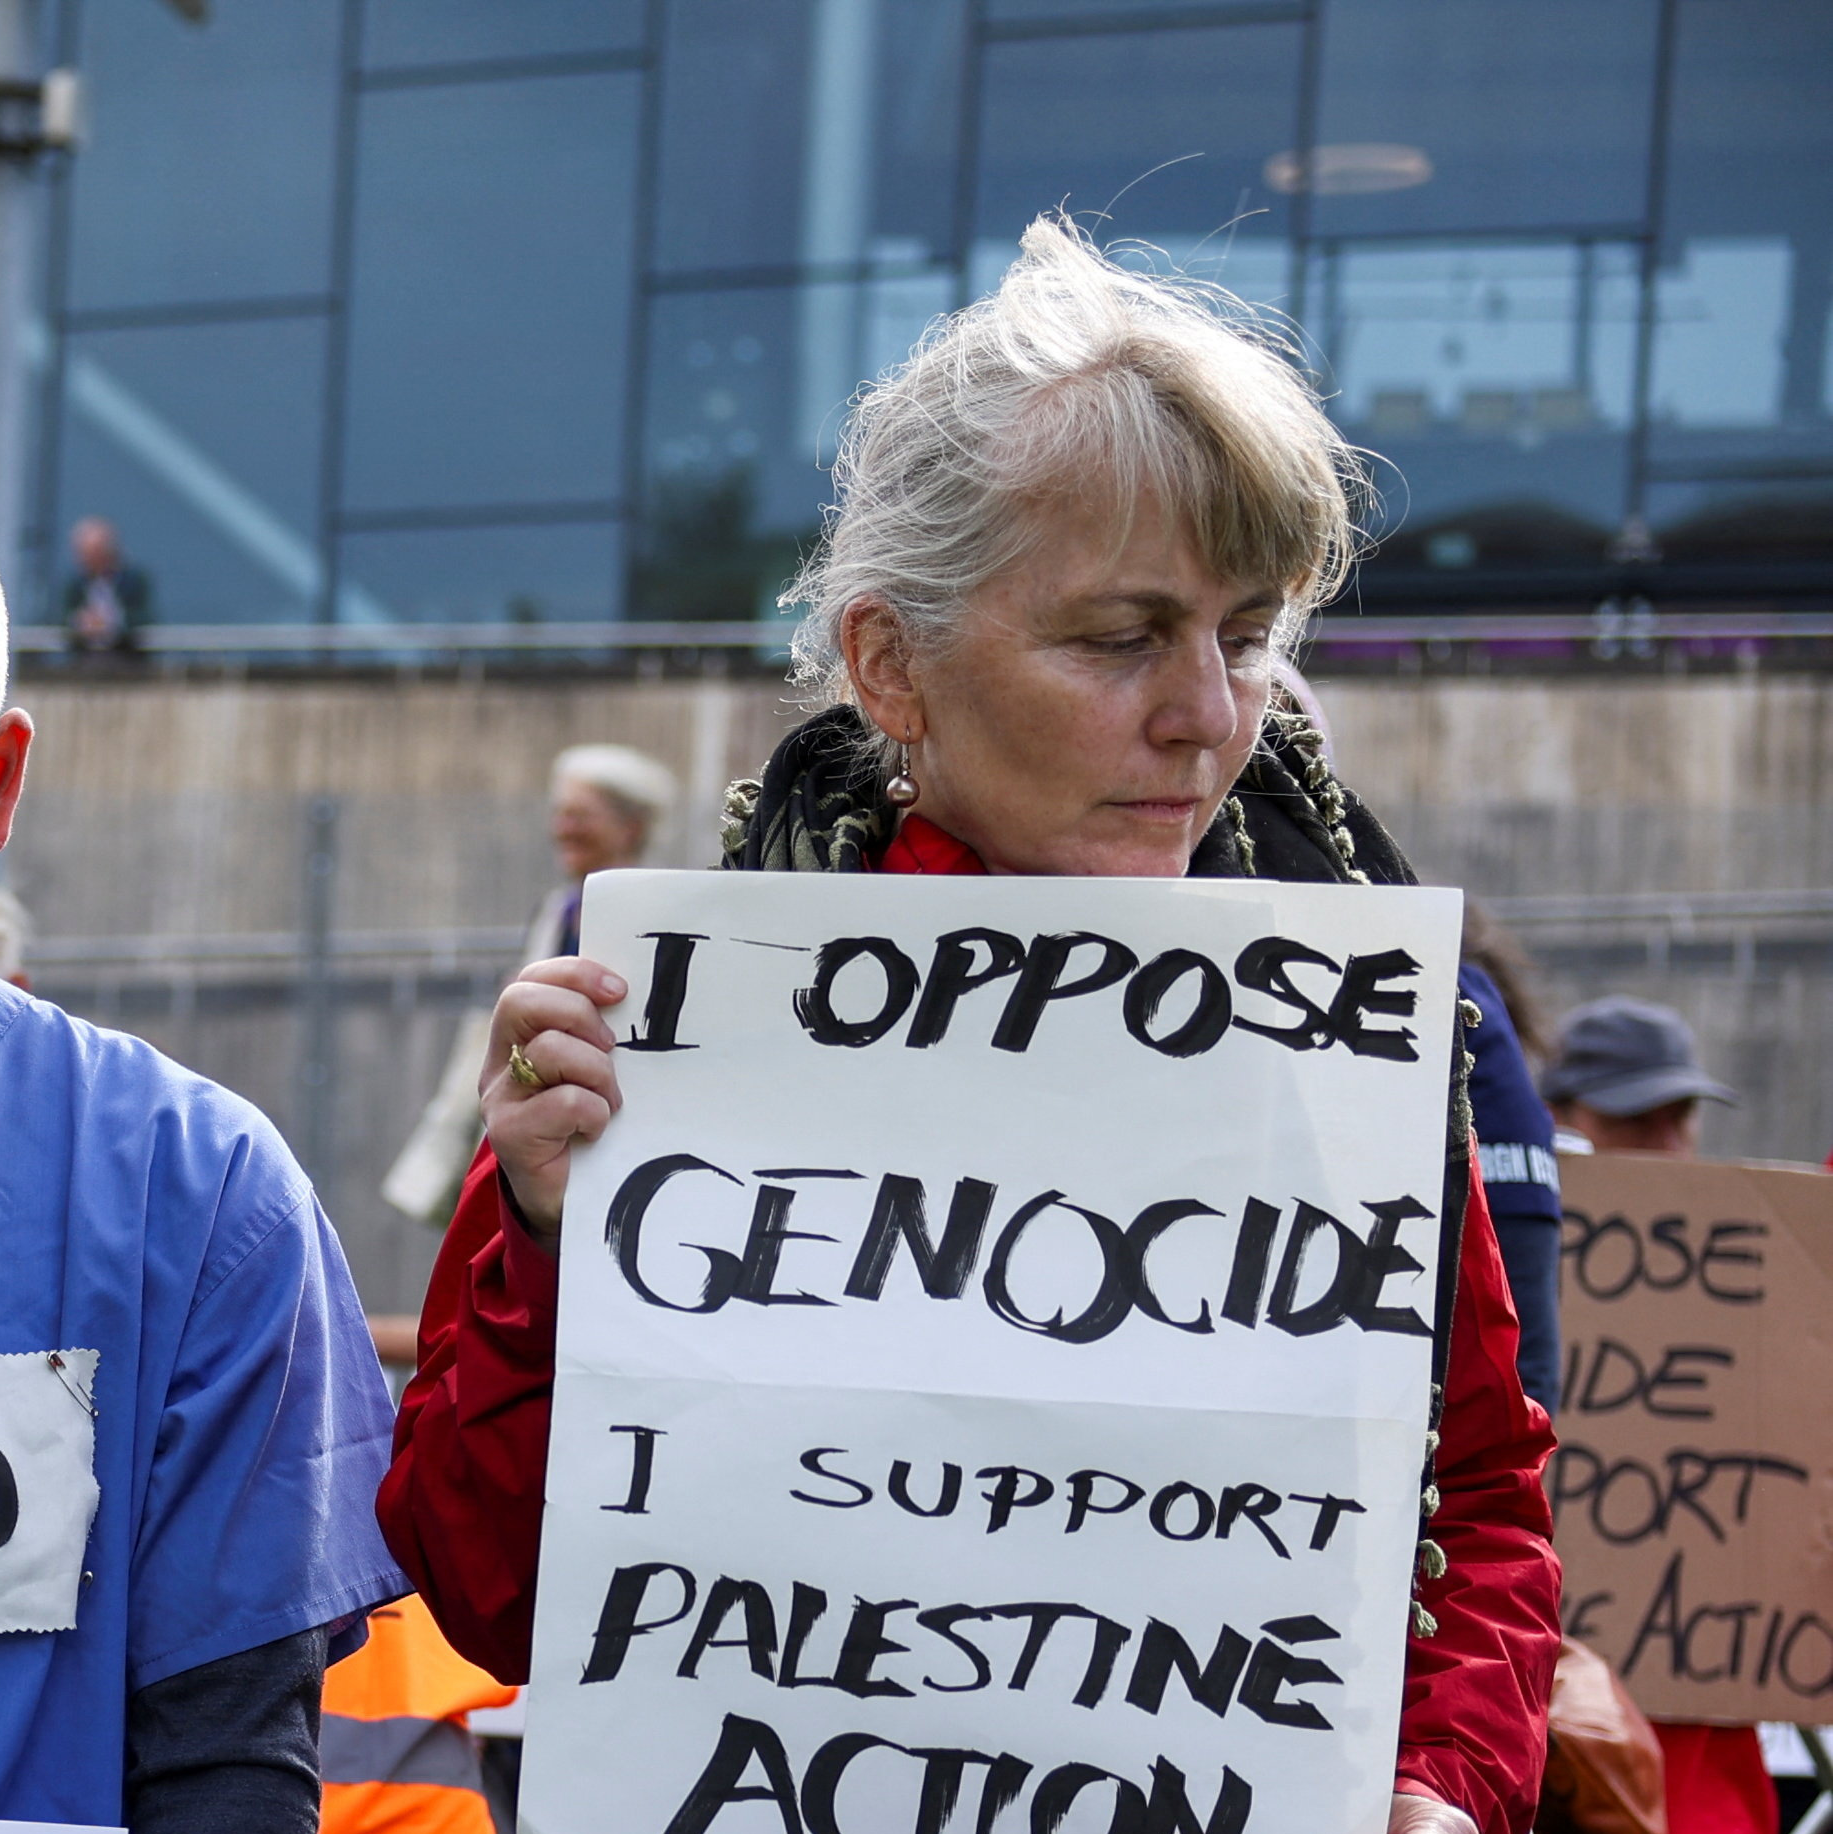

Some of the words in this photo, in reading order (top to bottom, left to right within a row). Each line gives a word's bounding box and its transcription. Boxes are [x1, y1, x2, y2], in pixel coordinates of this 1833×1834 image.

[616, 932, 710, 1052] I
[792, 926, 1423, 1062] OPPOSE
[605, 1154, 1435, 1344] GENOCIDE
[600, 1426, 666, 1514] I
[790, 1448, 1366, 1559] SUPPORT
[580, 1561, 1343, 1731] PALESTINE
